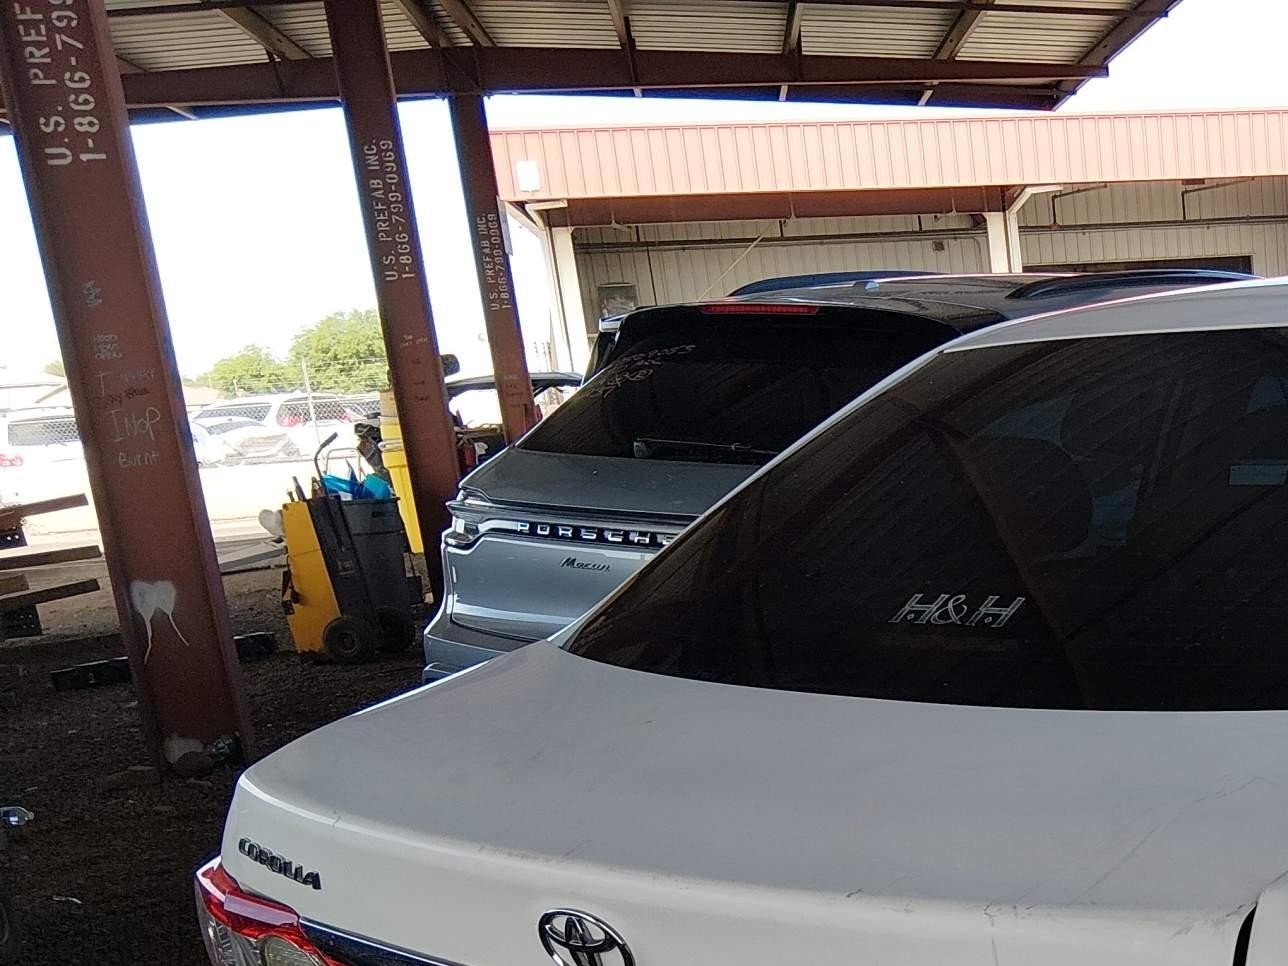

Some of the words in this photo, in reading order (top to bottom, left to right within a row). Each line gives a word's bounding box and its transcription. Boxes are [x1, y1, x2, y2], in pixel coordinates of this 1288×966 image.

[51, 0, 107, 162] 1-866-79
[39, 105, 72, 165] U.S.
[364, 139, 380, 170] INC.
[369, 179, 393, 241] PREFAB
[380, 140, 415, 279] 1-866-799-0969
[477, 213, 489, 235] INC.
[383, 250, 399, 281] U.S.
[480, 240, 496, 283] PREFAB
[489, 289, 500, 310] U.S.
[517, 521, 676, 545] PORSCHE
[561, 557, 610, 571] Macan
[238, 837, 322, 890] COROLLA
